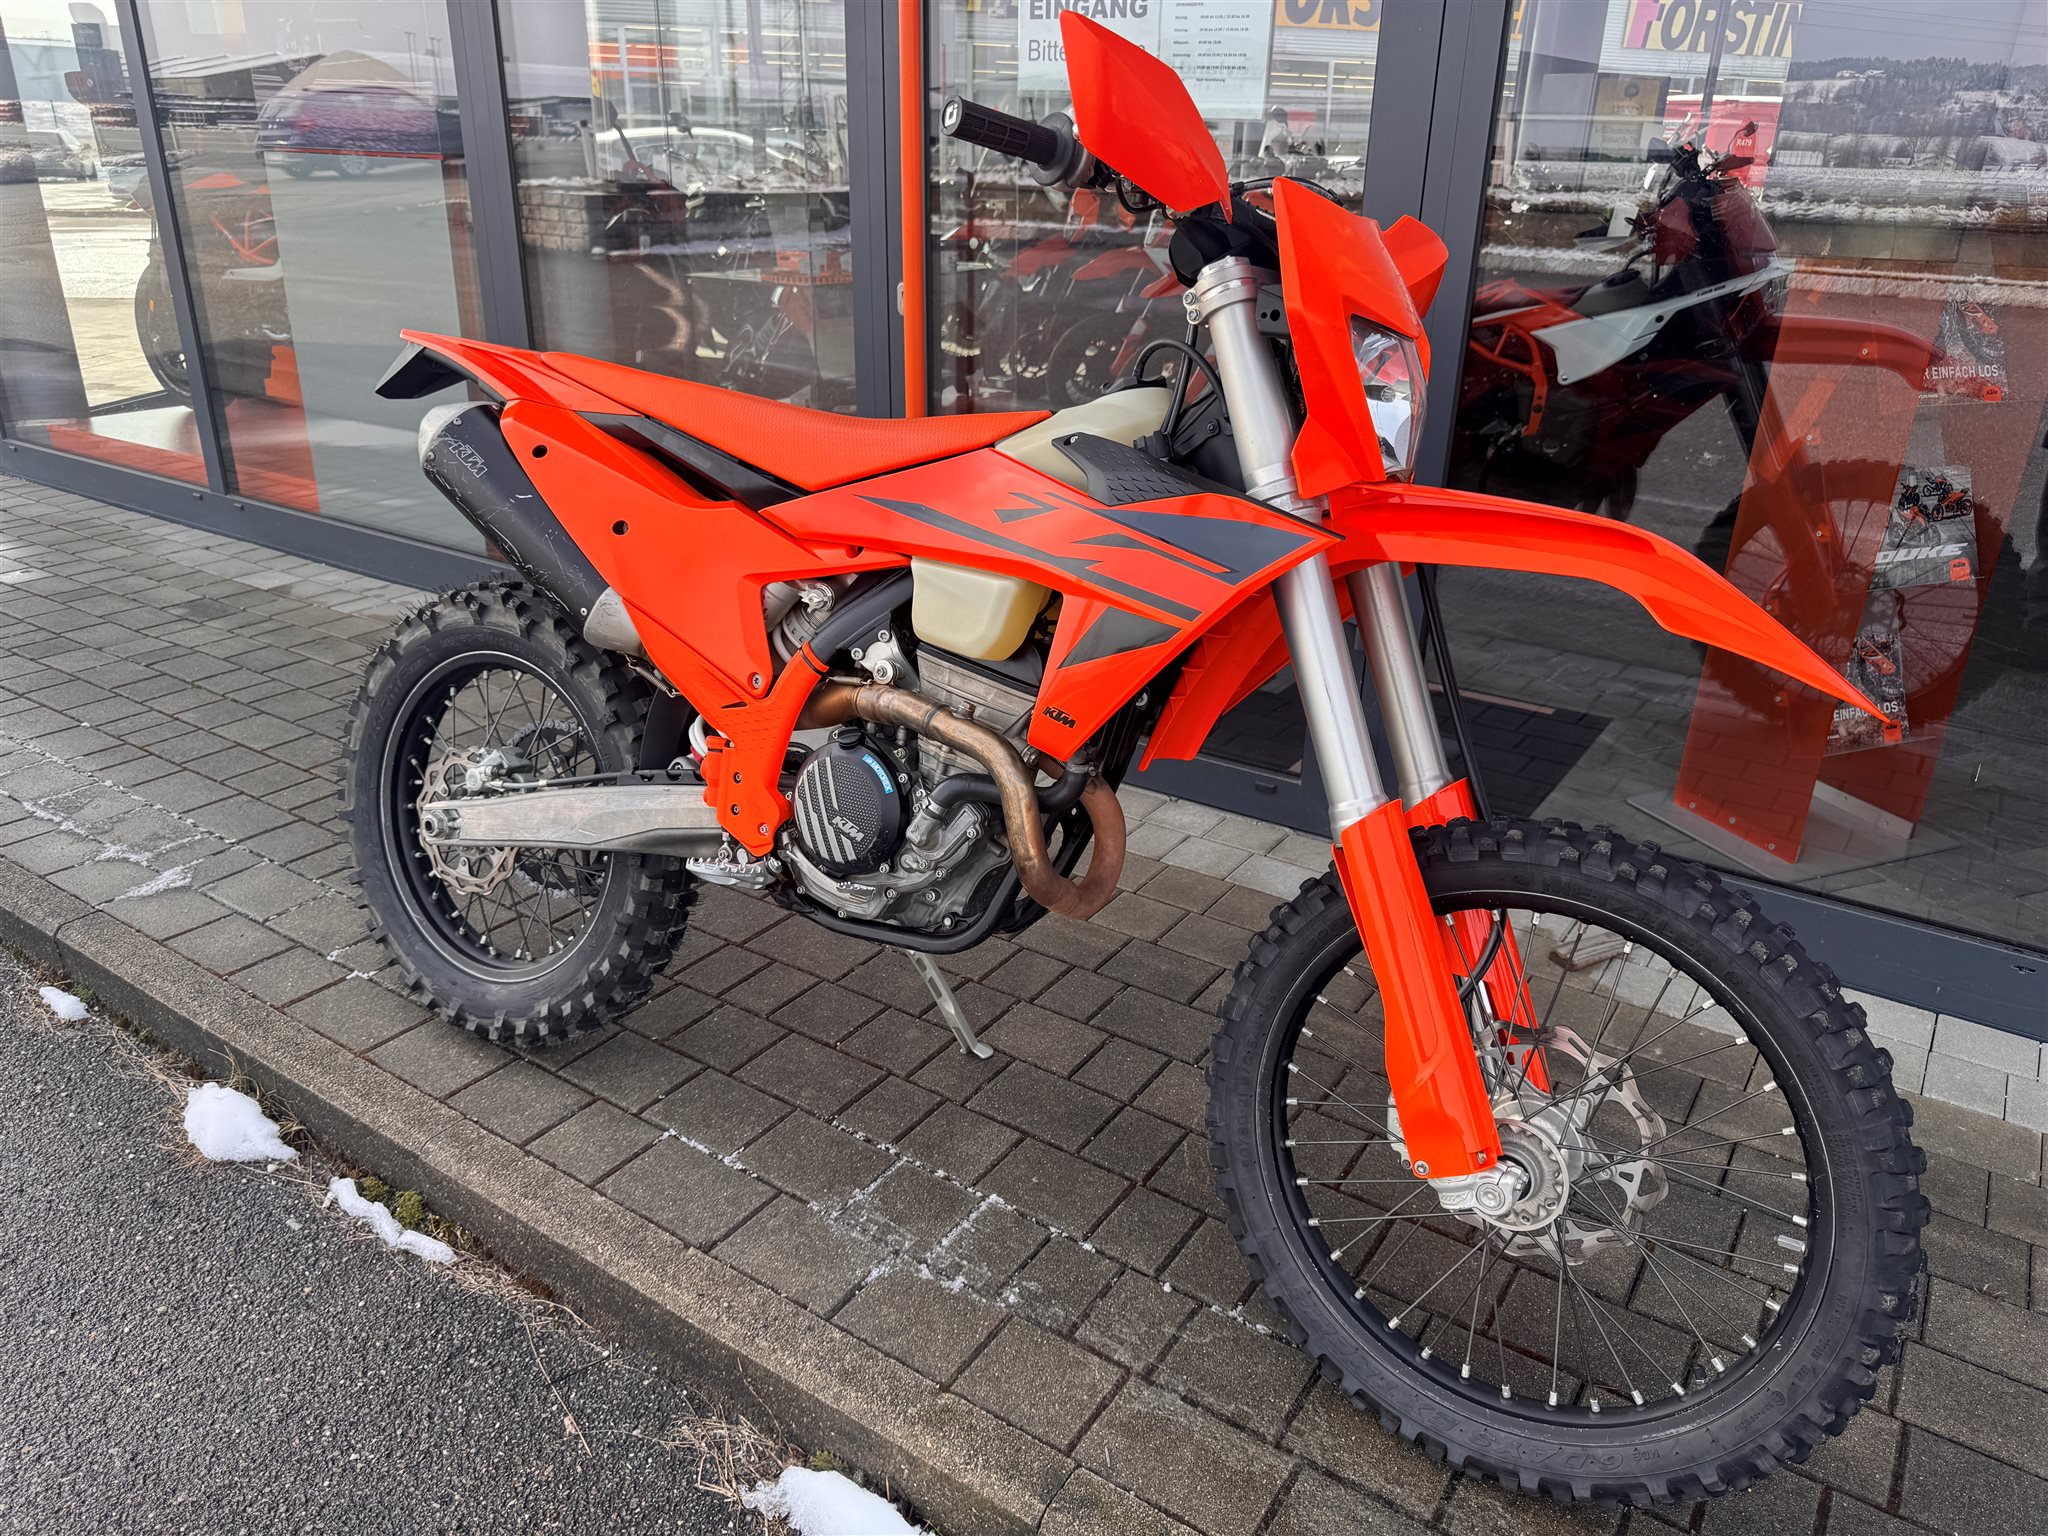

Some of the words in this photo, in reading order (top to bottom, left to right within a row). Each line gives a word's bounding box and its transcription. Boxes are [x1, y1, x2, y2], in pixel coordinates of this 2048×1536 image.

[1029, 0, 1148, 20] EINGANG
[1932, 365, 1976, 380] EINFACH
[1978, 364, 1999, 378] LOS
[449, 443, 488, 478] KTM
[1874, 542, 1968, 564] DUKE
[1042, 706, 1077, 729] KTM
[1833, 707, 1873, 721] EINFAC
[831, 815, 865, 842] KTM
[1467, 1429, 1590, 1470] DAYS
